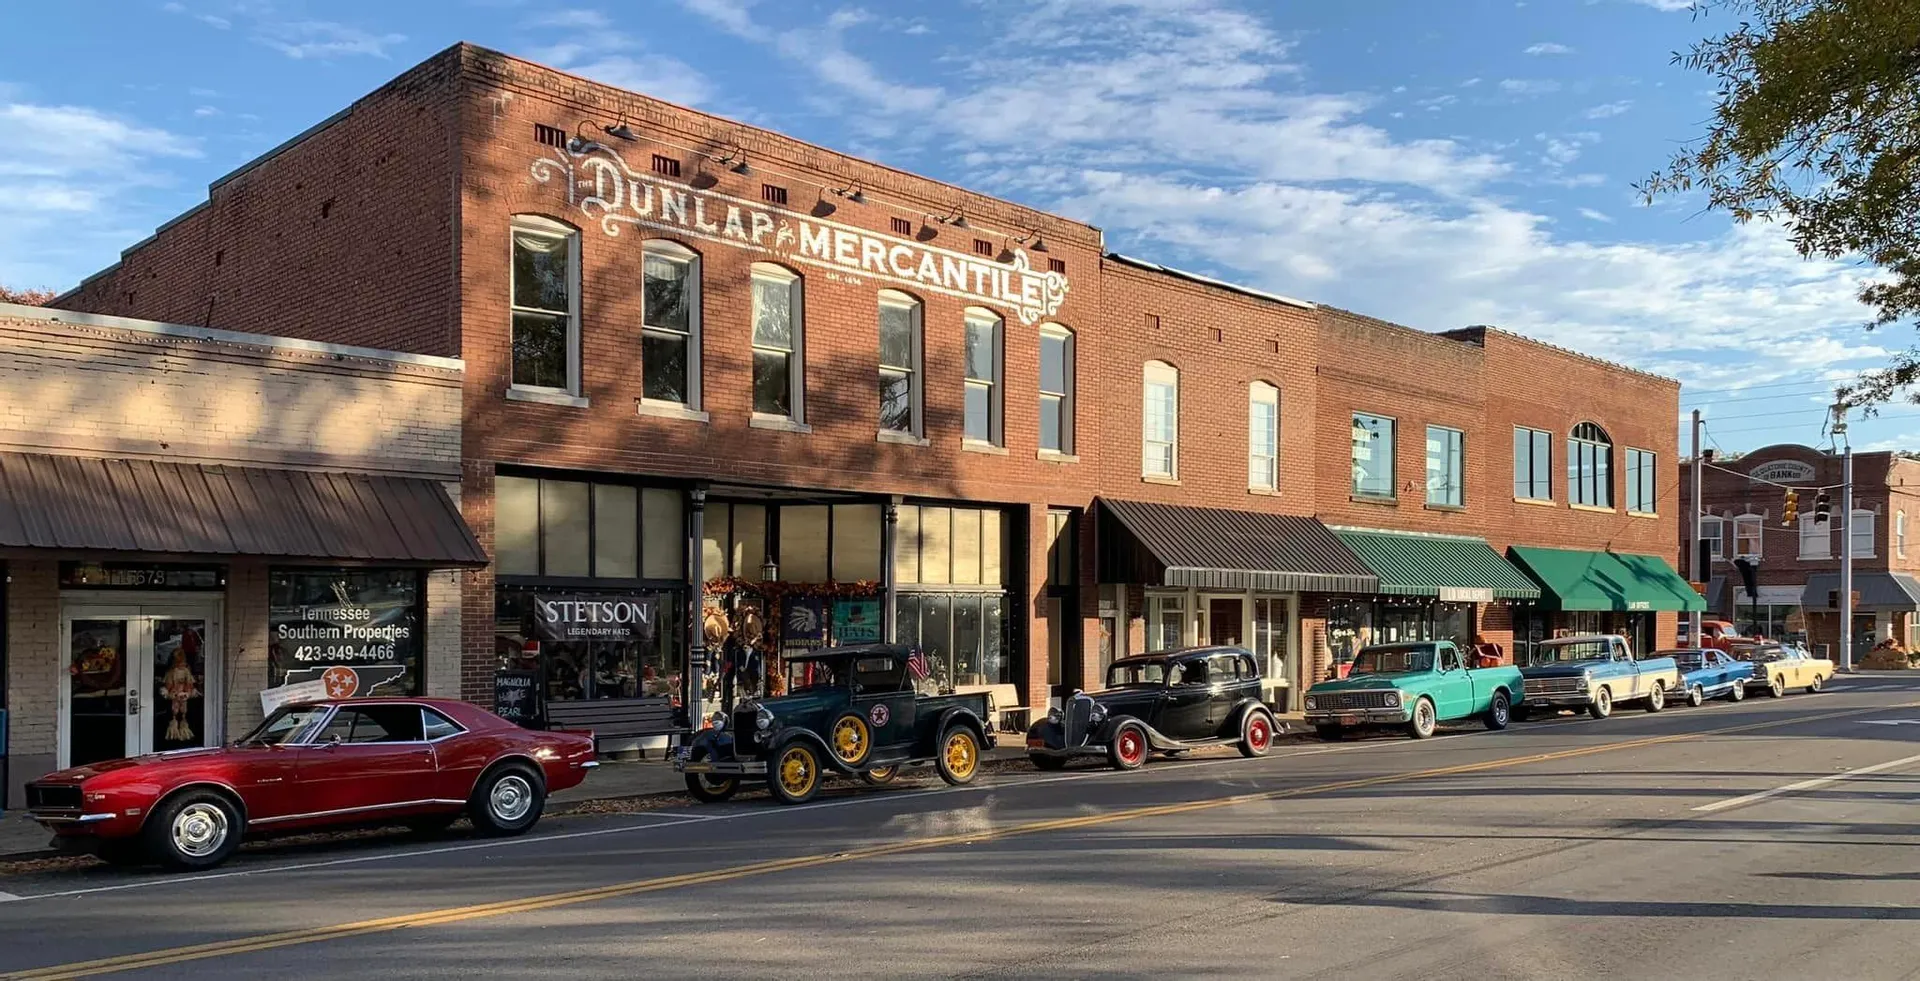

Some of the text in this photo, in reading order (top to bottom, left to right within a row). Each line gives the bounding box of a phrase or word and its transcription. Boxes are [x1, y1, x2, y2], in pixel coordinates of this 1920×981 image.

[577, 157, 1043, 307] THE DUNLAP MERCANTILE
[1769, 470, 1793, 479] BANK
[299, 605, 371, 621] Tennessee
[545, 600, 648, 624] STETSON
[278, 623, 410, 642] Southern Properties
[567, 627, 631, 636] LEGENDARY HATS
[785, 638, 822, 647] INDIANS
[294, 644, 394, 661] 423-949-4466
[496, 676, 531, 687] MAGNOLIA
